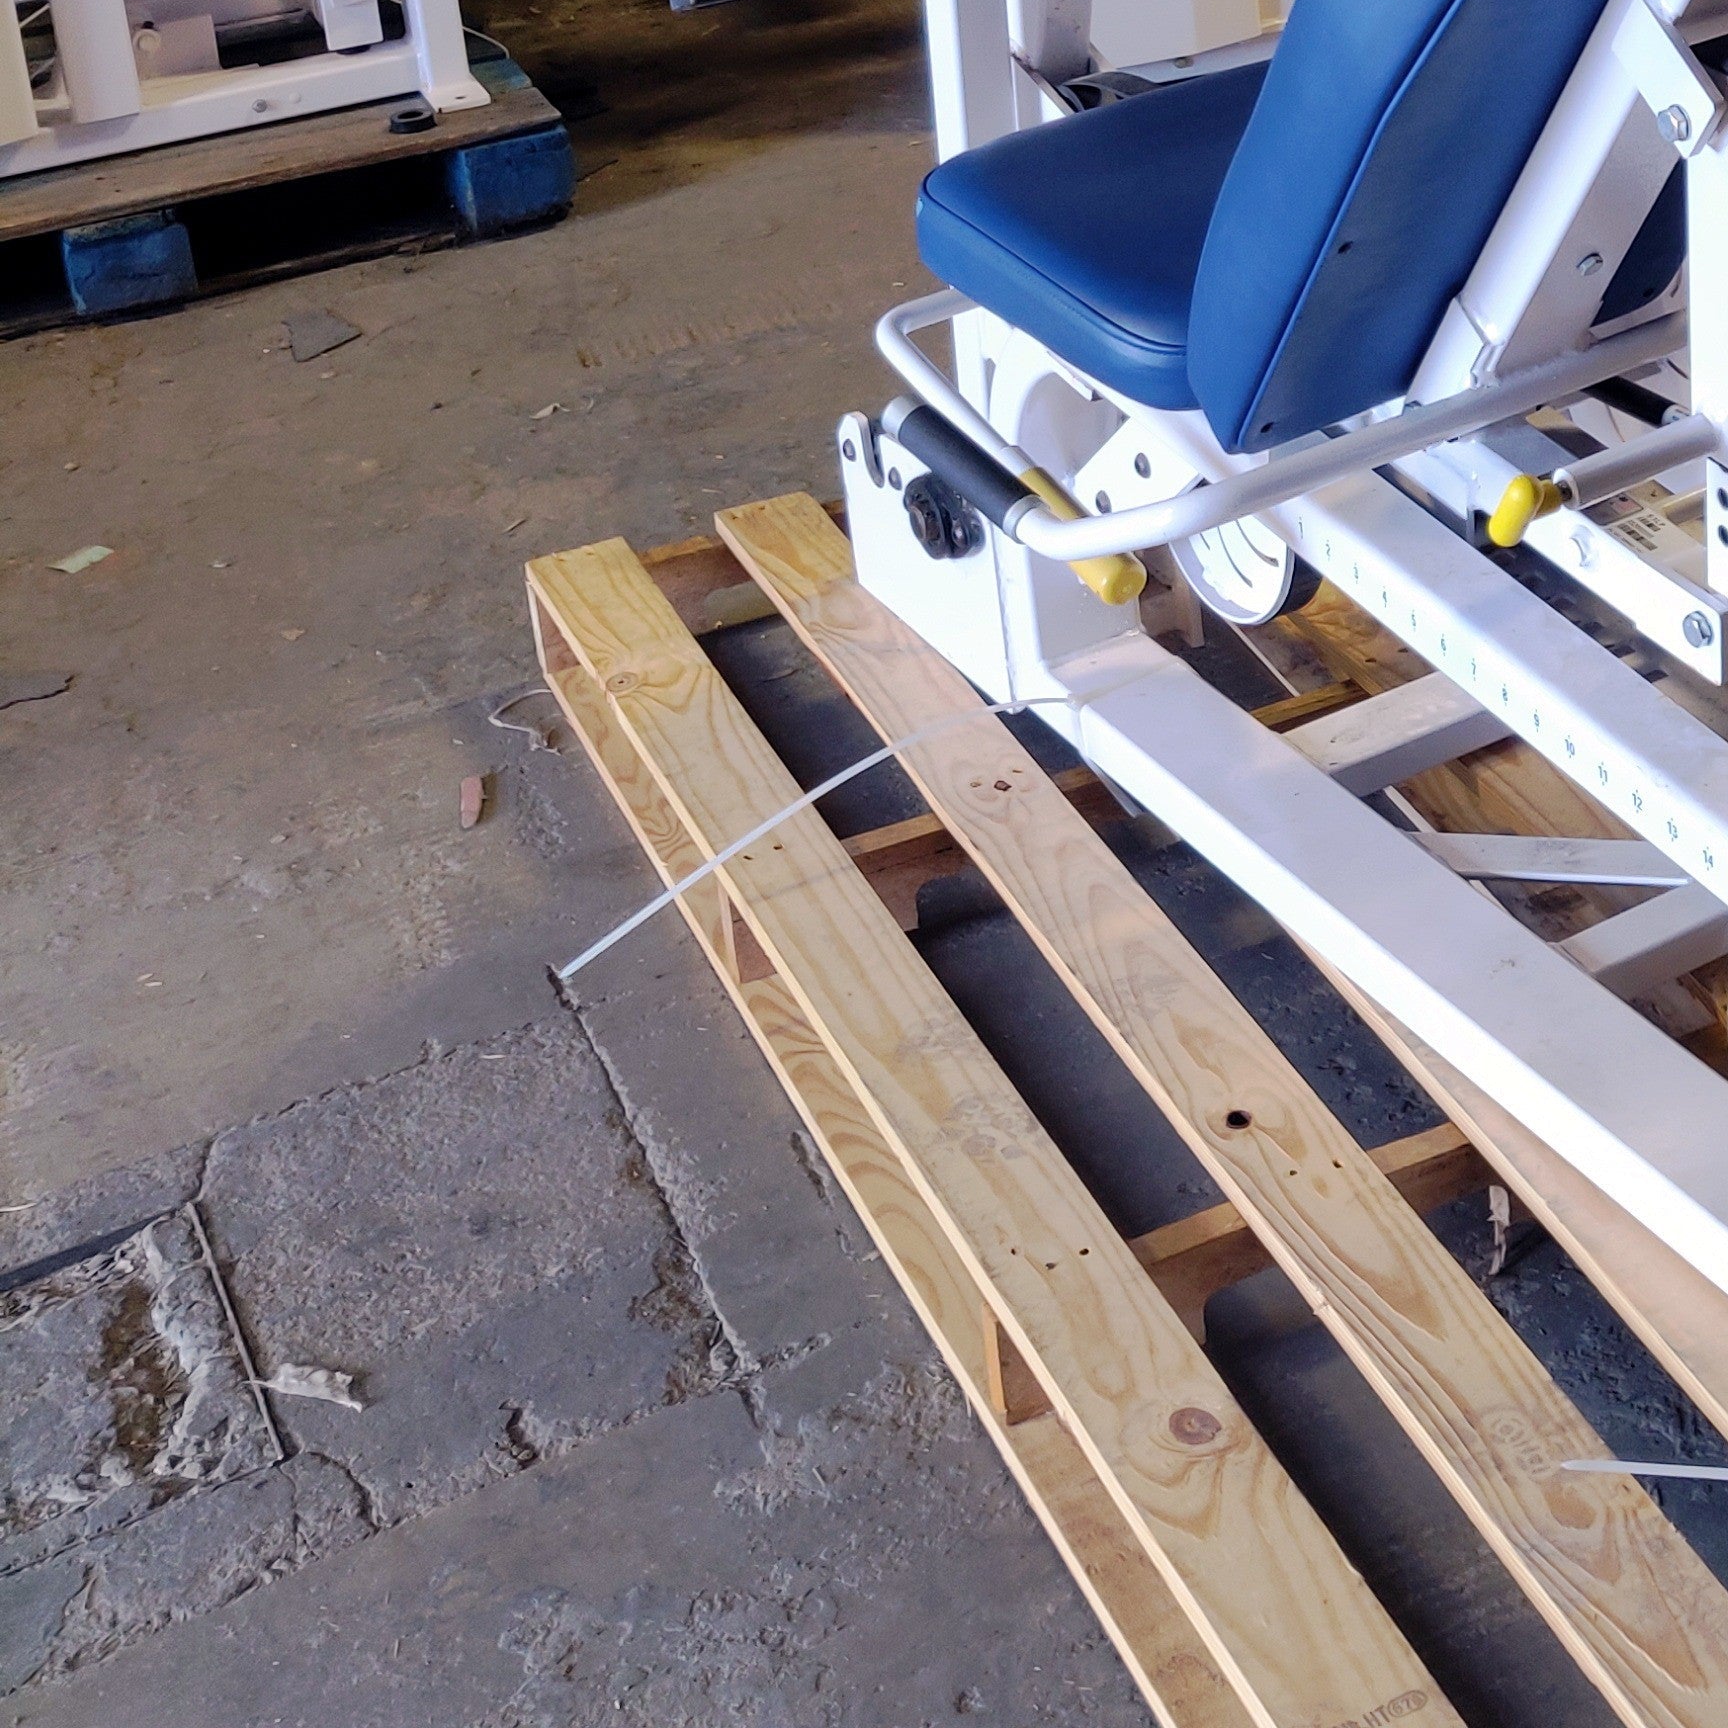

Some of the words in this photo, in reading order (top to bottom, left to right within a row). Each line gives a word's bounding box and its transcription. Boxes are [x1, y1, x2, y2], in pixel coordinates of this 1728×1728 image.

[1564, 738, 1576, 756] 10
[1597, 765, 1609, 783] 11
[1631, 792, 1643, 811] 12
[1666, 821, 1678, 839] 13
[1702, 849, 1714, 868] 14
